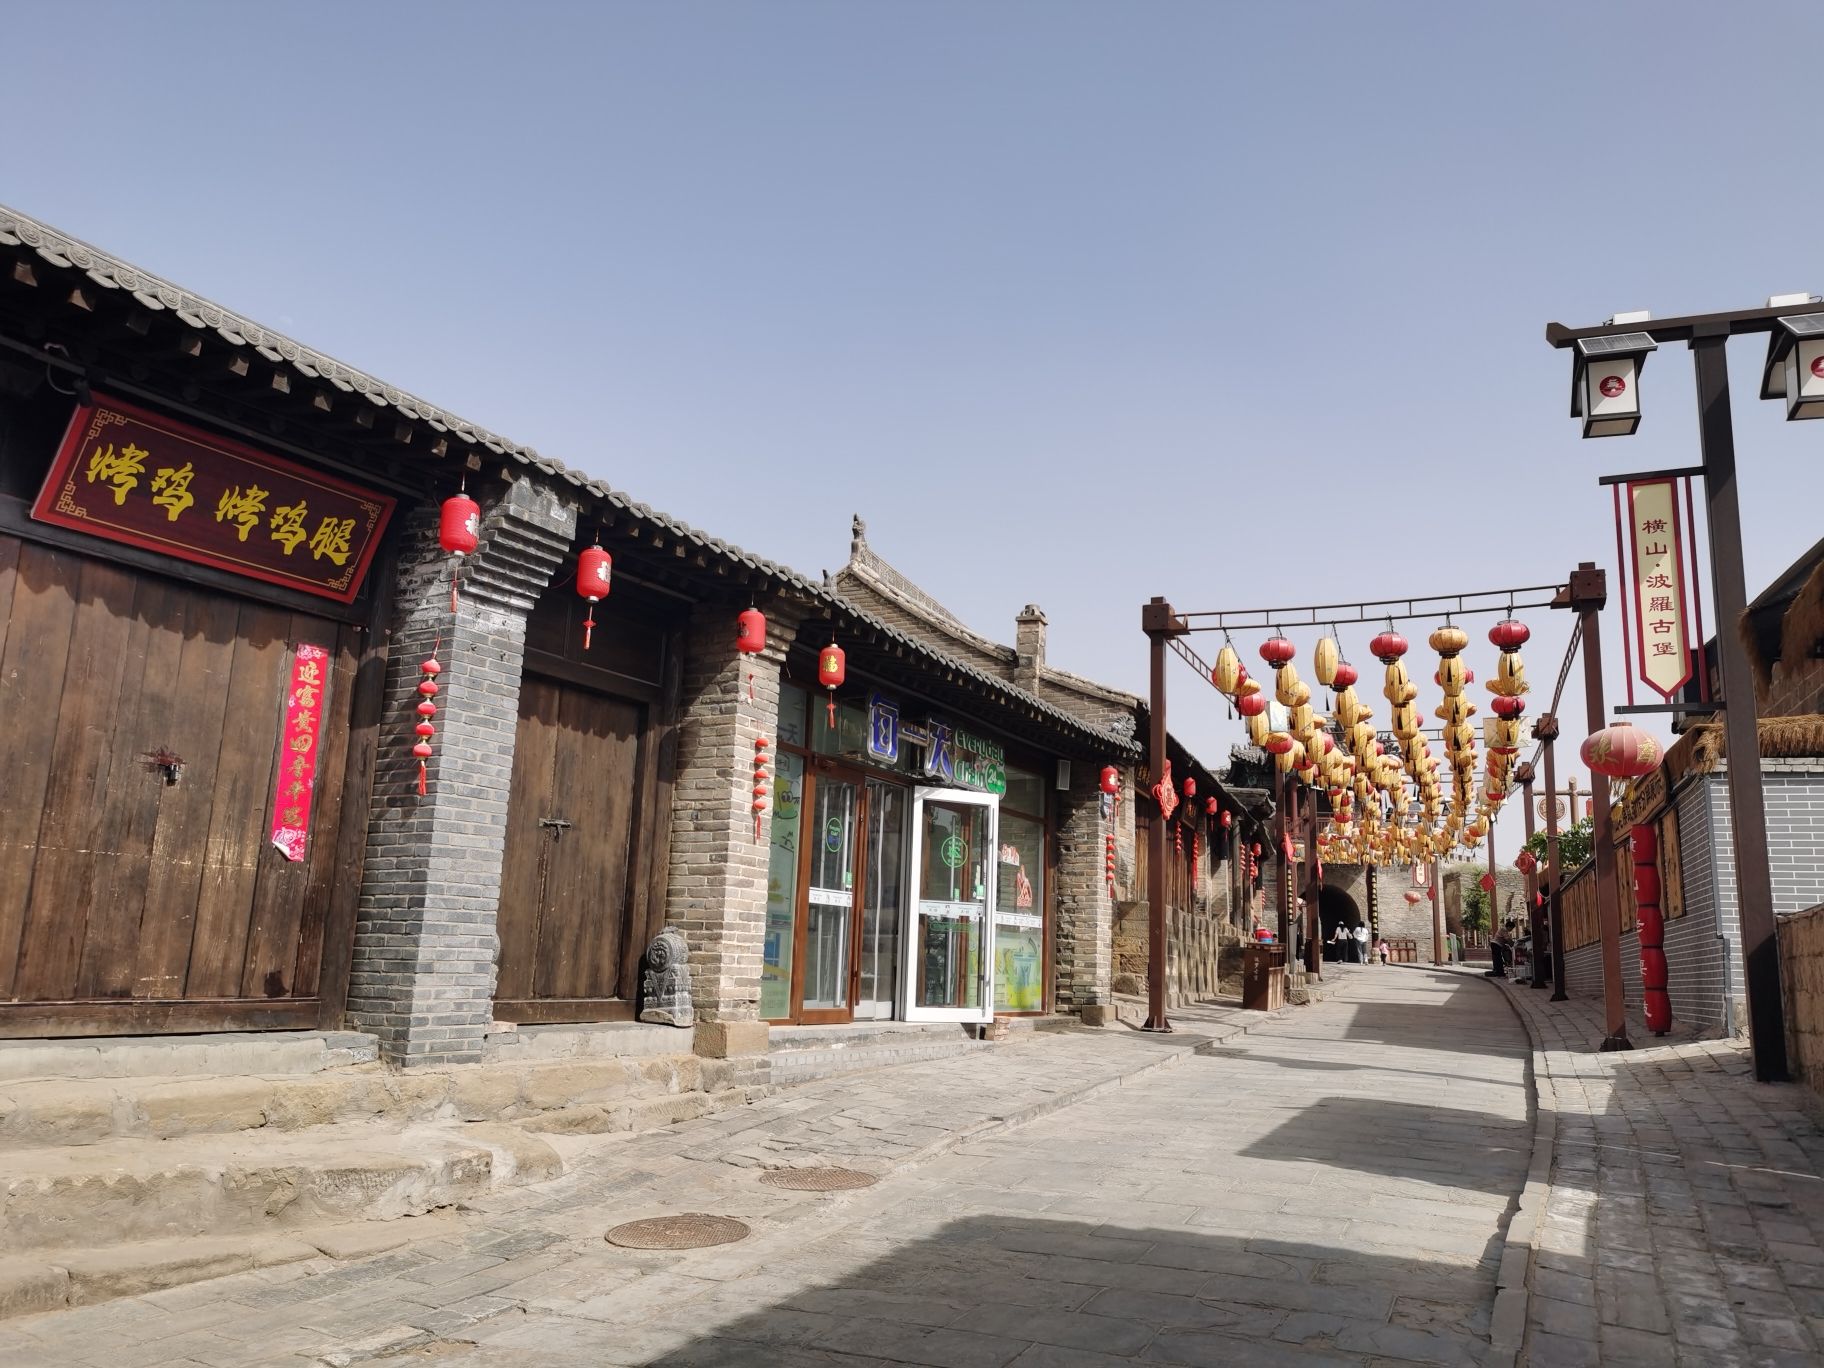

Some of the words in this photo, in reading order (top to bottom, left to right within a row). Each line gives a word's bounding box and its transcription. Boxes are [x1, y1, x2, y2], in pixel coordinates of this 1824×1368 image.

[84, 442, 195, 522] 烤鸡
[215, 484, 358, 567] 烤鸡腿
